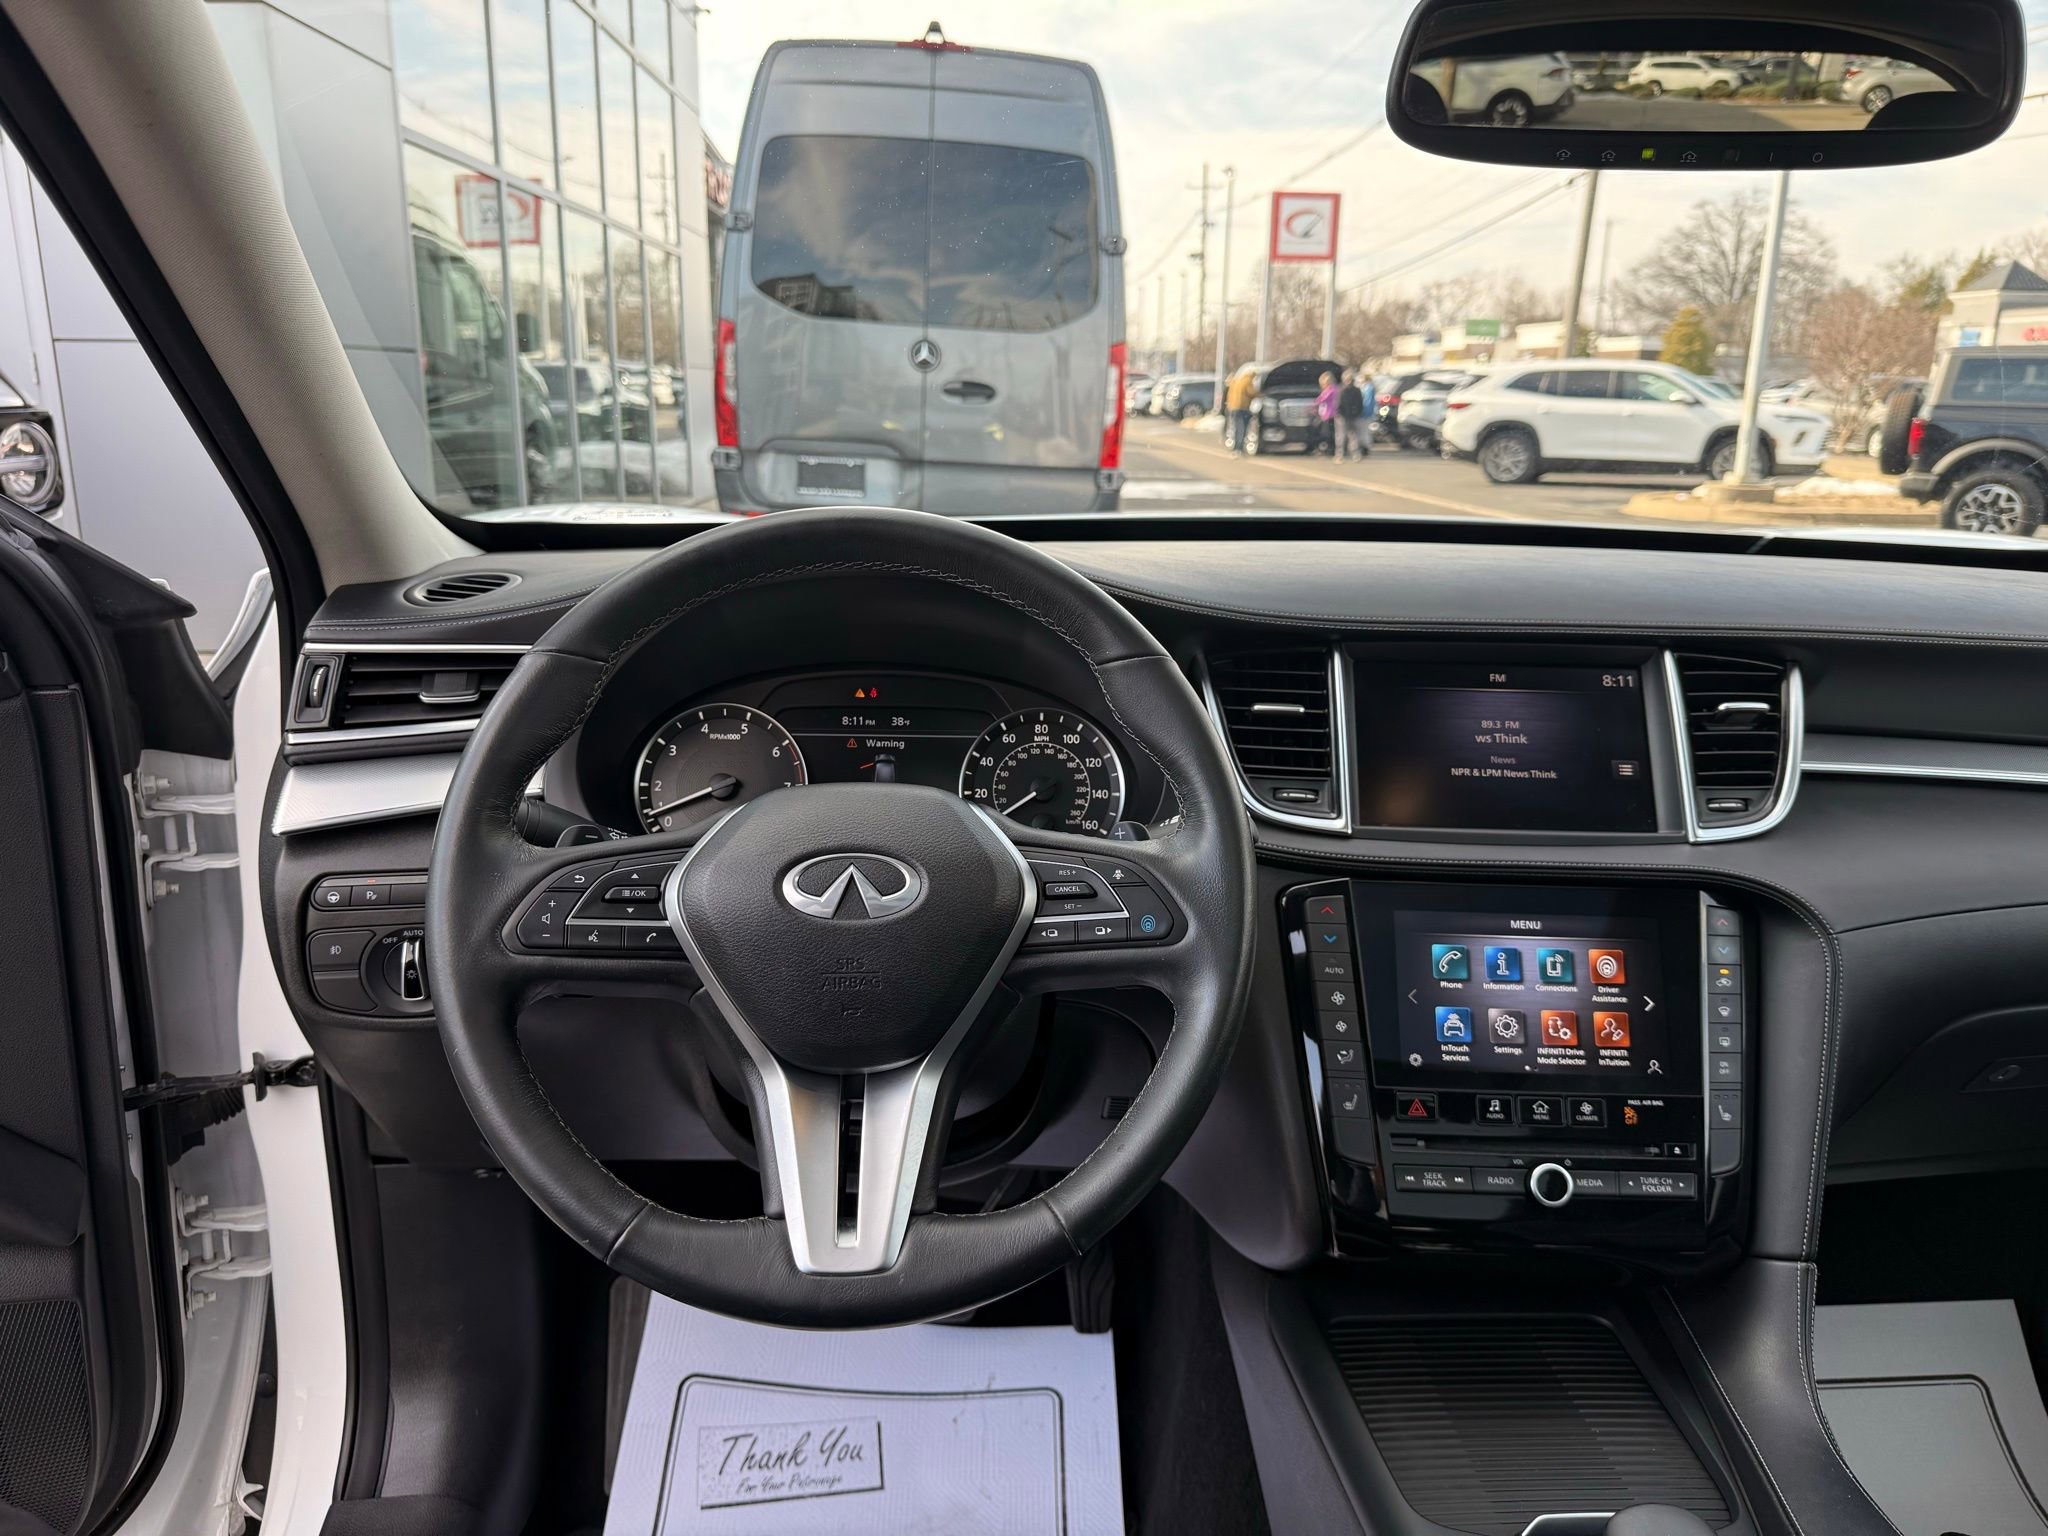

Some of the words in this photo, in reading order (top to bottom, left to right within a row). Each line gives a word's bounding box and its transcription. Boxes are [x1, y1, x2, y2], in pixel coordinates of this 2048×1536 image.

[1489, 673, 1505, 683] FM
[1602, 674, 1634, 688] 8:11
[841, 716, 864, 726] 8:11
[1480, 720, 1501, 729] 89.3
[1504, 720, 1520, 729] FM
[700, 723, 709, 734] 4
[740, 723, 749, 735] 5
[1034, 724, 1049, 734] 80
[1002, 733, 1016, 744] 60
[1062, 734, 1081, 744] 100
[1474, 735, 1491, 744] ws
[1493, 733, 1528, 744] Think
[865, 739, 905, 750] Warning
[668, 744, 677, 756] 3
[771, 746, 781, 758] 6
[979, 756, 994, 767] 40
[1085, 757, 1102, 768] 120
[1490, 755, 1516, 764] News
[1450, 767, 1472, 777] NPR
[1472, 768, 1480, 777] &
[1481, 768, 1502, 777] LPM
[1503, 769, 1529, 778] News
[1529, 769, 1557, 779] Think
[653, 780, 663, 792] 2
[974, 788, 988, 799] 20
[1091, 789, 1109, 799] 140
[664, 815, 673, 827] 0
[1081, 820, 1099, 830] 160
[1054, 885, 1081, 893] CANCEL
[1510, 920, 1541, 930] MENU
[382, 936, 399, 944] OFF
[1324, 967, 1344, 975] AUTO
[822, 976, 882, 991] AIRBAG
[1440, 981, 1463, 989] Phone
[1483, 982, 1525, 990] Information
[1535, 984, 1578, 992] Connections
[1598, 986, 1619, 994] Driver
[1591, 995, 1627, 1003] Assistance
[1440, 1044, 1470, 1052] InTouch
[1494, 1046, 1523, 1056] Settings
[1565, 1048, 1585, 1056] Drive
[1441, 1053, 1470, 1062] Services
[1537, 1057, 1558, 1065] Mode
[1558, 1057, 1587, 1065] Selector
[1423, 1172, 1443, 1180] SEEK
[1487, 1176, 1514, 1185] RADIO
[1422, 1179, 1447, 1188] TRACK
[1576, 1178, 1604, 1187] MEDIA
[1642, 1185, 1672, 1193] FOLDER
[718, 1430, 812, 1476] Thank
[819, 1426, 864, 1468] You
[735, 1476, 758, 1495] For
